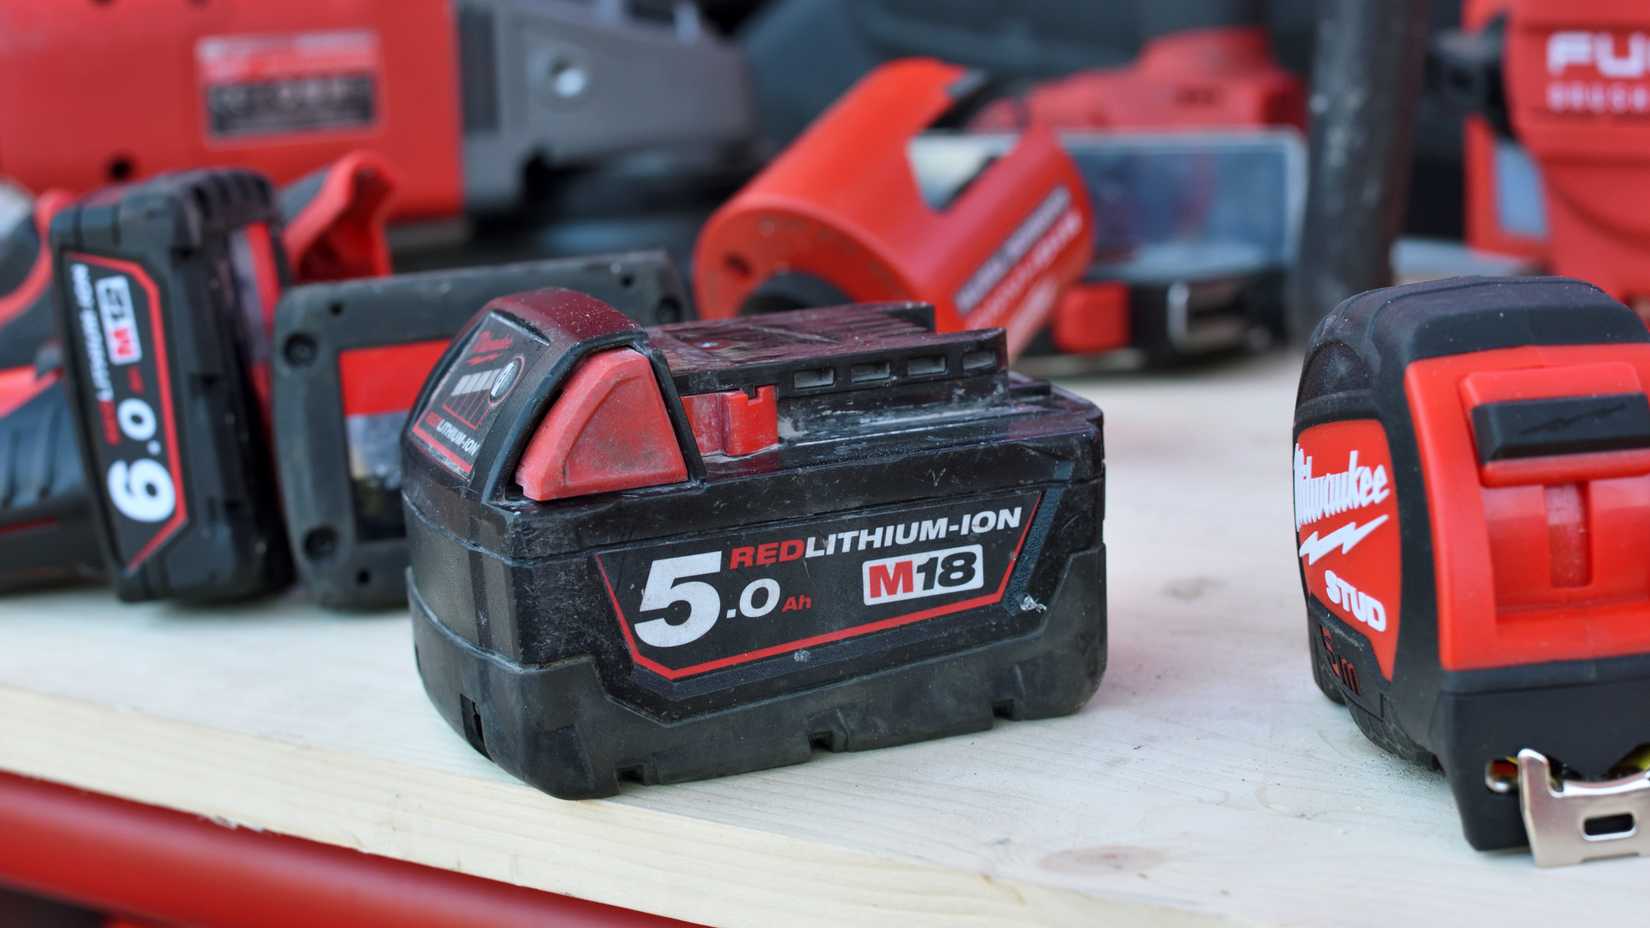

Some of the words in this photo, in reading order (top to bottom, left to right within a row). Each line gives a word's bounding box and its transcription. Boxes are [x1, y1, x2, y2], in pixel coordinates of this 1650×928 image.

[1546, 32, 1650, 78] FU
[107, 398, 176, 522] 6.0
[1293, 442, 1390, 530] Milwaukee
[730, 506, 1023, 569] REDLITHIUM-ION
[633, 549, 782, 648] 5.0
[781, 594, 813, 613] Ah
[867, 551, 978, 599] M18
[1324, 569, 1387, 633] STUD
